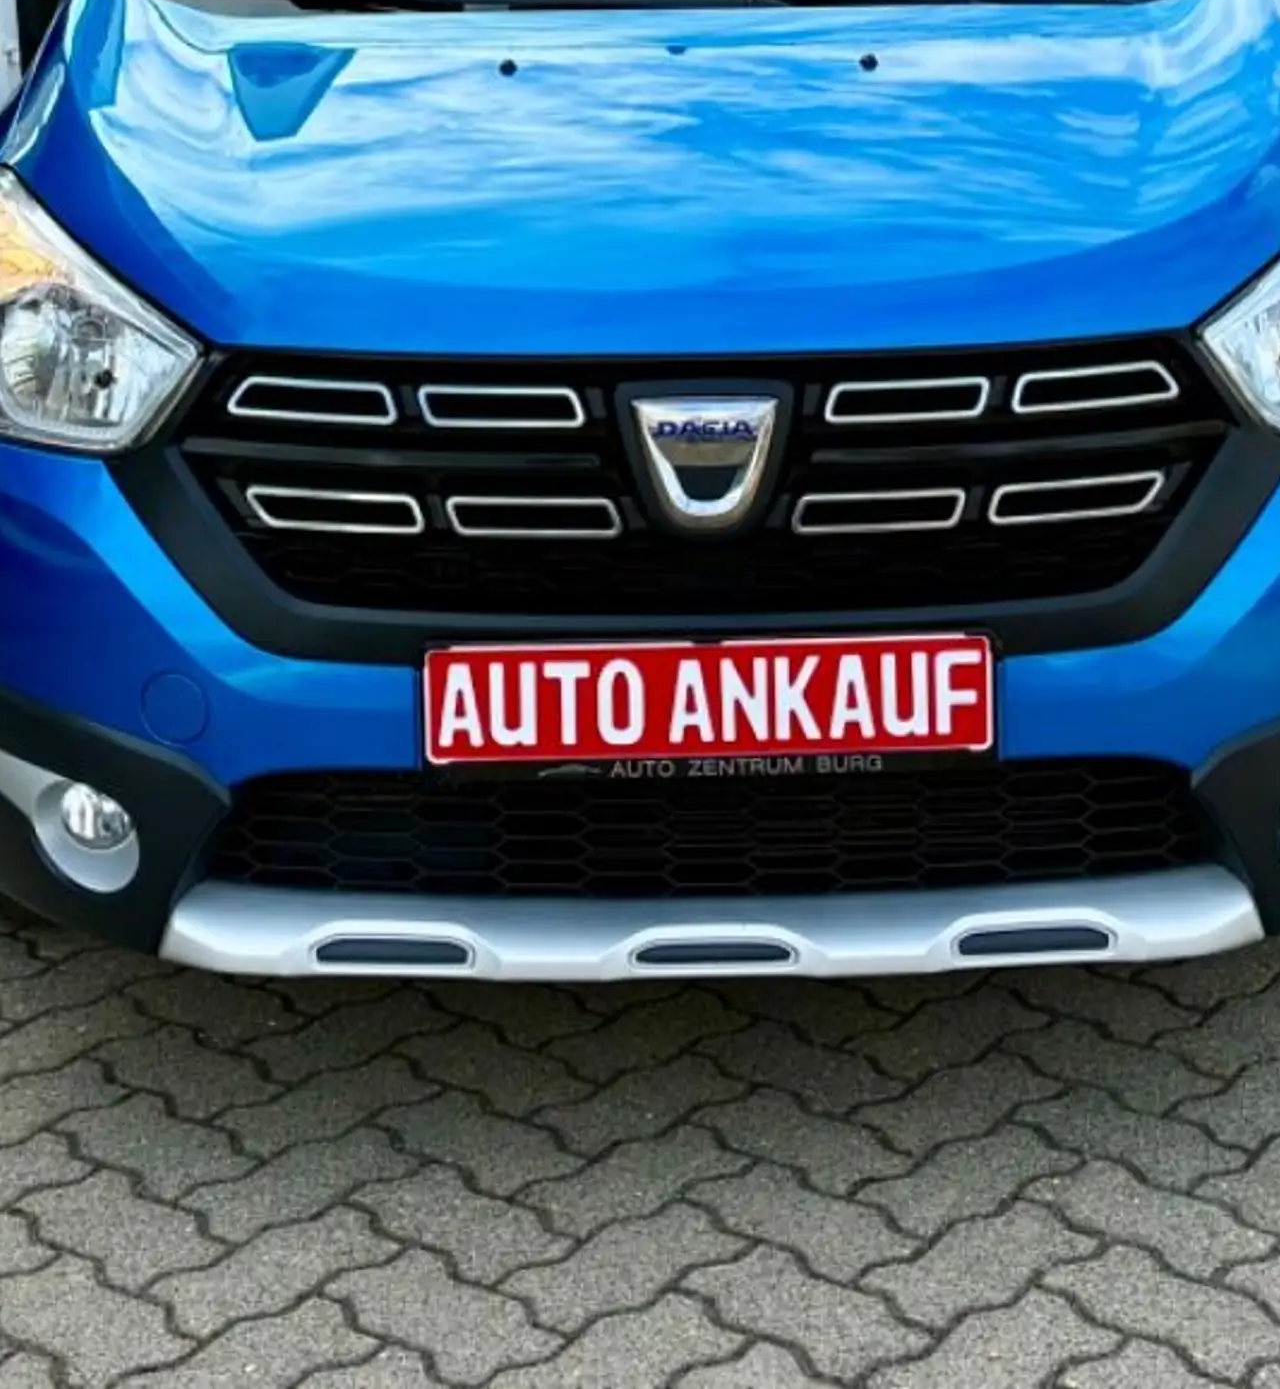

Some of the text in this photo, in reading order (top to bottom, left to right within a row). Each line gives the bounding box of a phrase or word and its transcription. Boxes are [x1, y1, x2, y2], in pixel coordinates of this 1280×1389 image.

[438, 650, 983, 748] AUTO ANKAUF
[609, 754, 883, 779] AUTO ZENTRUM BURG
